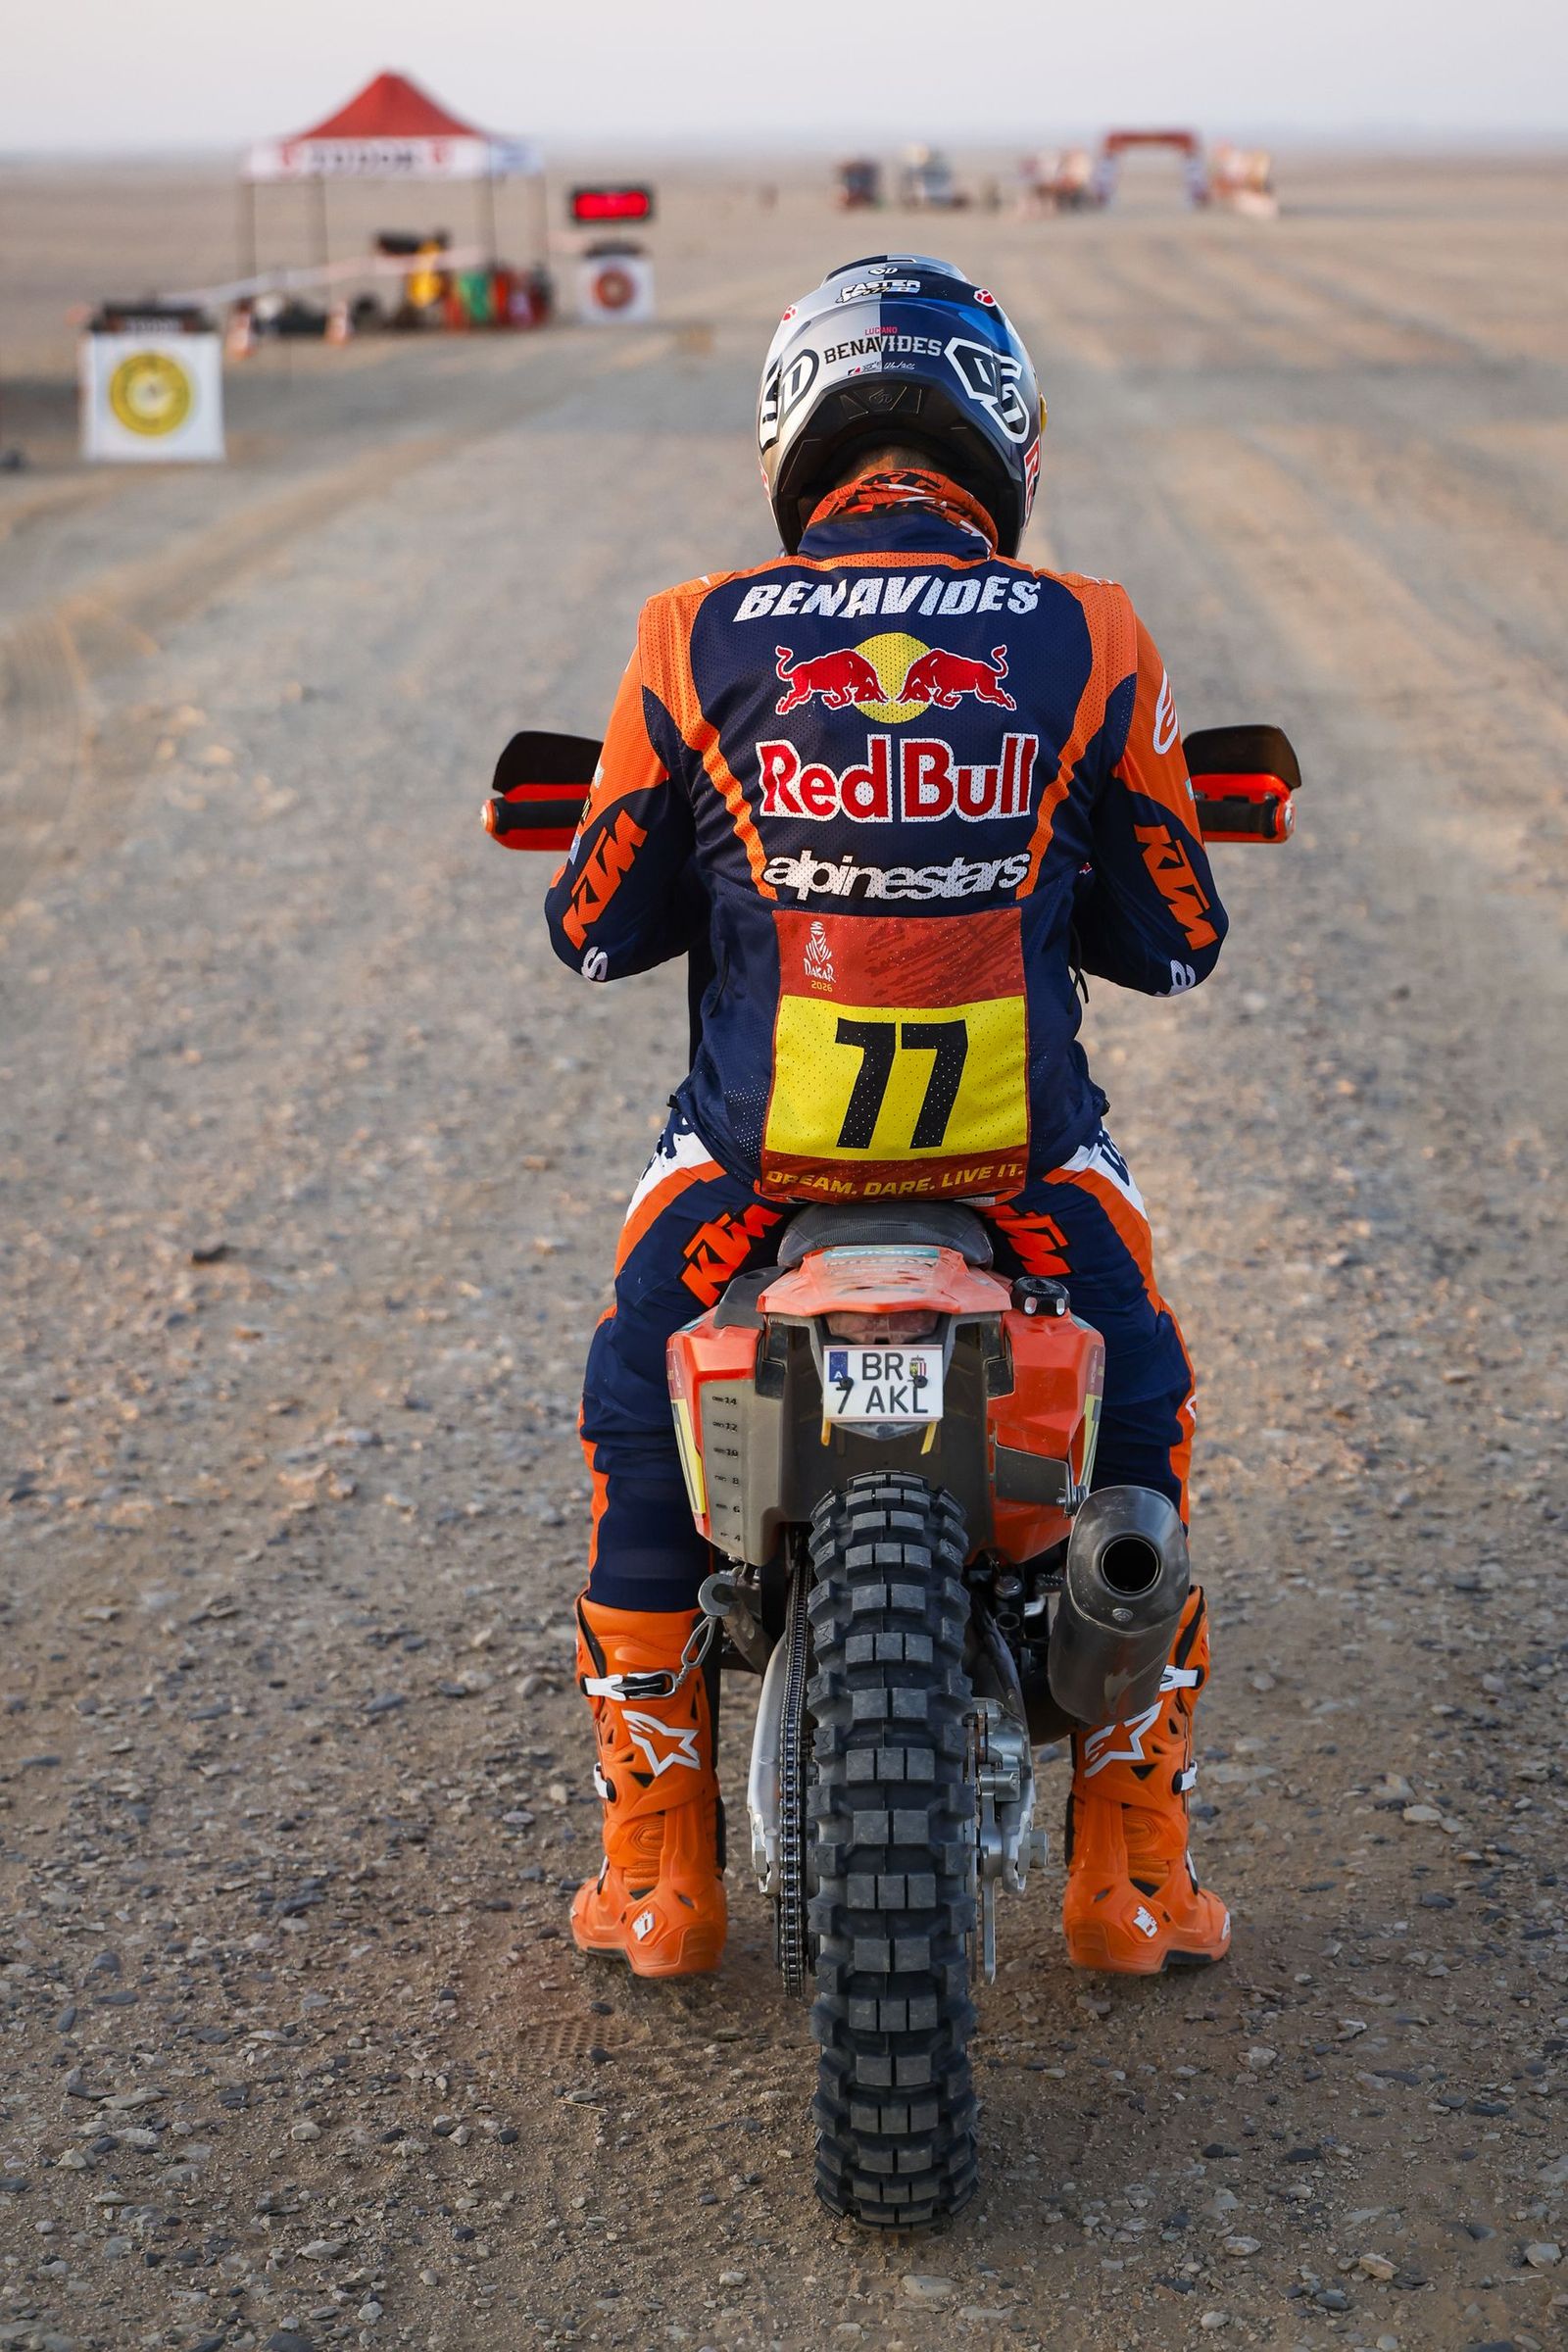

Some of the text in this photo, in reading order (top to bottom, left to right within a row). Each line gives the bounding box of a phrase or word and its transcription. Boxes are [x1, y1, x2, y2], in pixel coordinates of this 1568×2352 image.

[823, 335, 943, 365] BENAVIDES
[864, 326, 899, 335] LUCIANO
[732, 575, 1042, 622] BENAVIDES
[756, 732, 1039, 822] Red Bull
[563, 808, 648, 951] KTM
[763, 850, 1031, 901] alpinestars
[1134, 824, 1219, 951] KTM
[811, 980, 833, 993] 2026
[835, 1017, 968, 1150] 77
[766, 1163, 1024, 1196] DREAM. DARE. LIVE IT.
[681, 1203, 783, 1308] KTM
[862, 1352, 904, 1381] BR
[836, 1382, 928, 1414] 7 AKL
